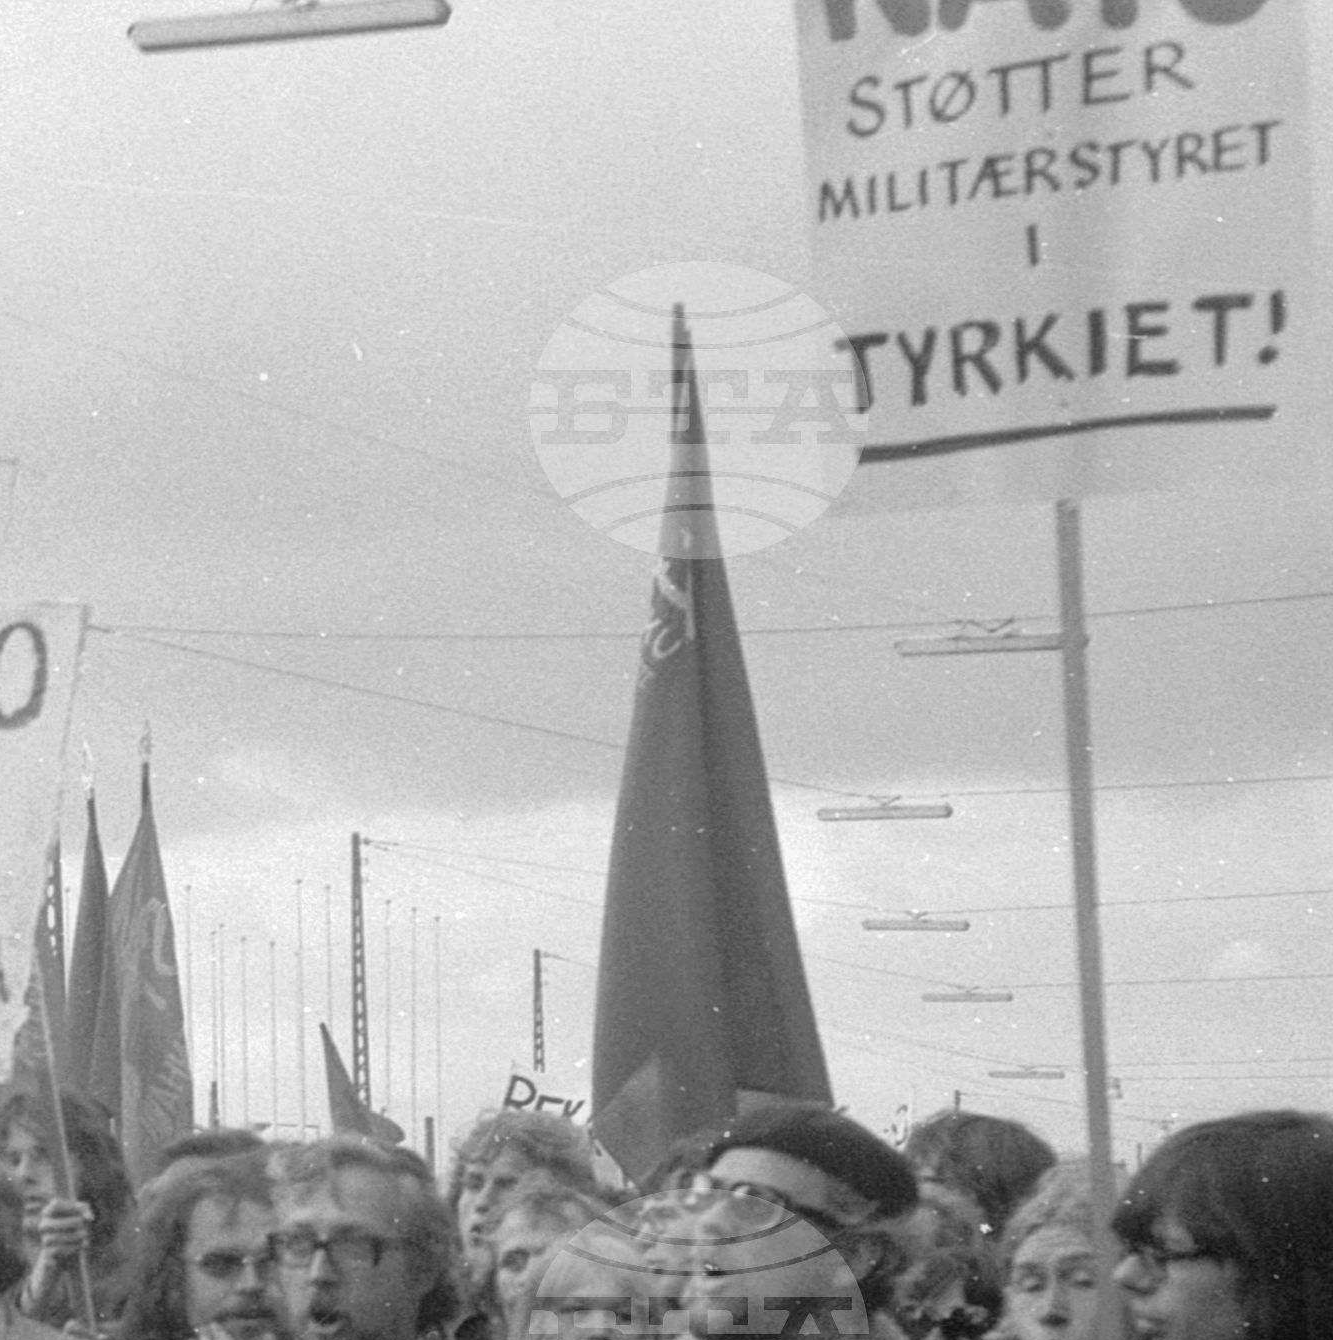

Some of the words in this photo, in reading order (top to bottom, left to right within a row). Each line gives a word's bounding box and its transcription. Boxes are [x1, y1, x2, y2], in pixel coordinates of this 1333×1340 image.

[845, 40, 1196, 138] STØTTER
[816, 119, 1284, 224] MILITÆRSTYRET
[1025, 222, 1041, 268] I
[833, 289, 1288, 414] TYRKIET!
